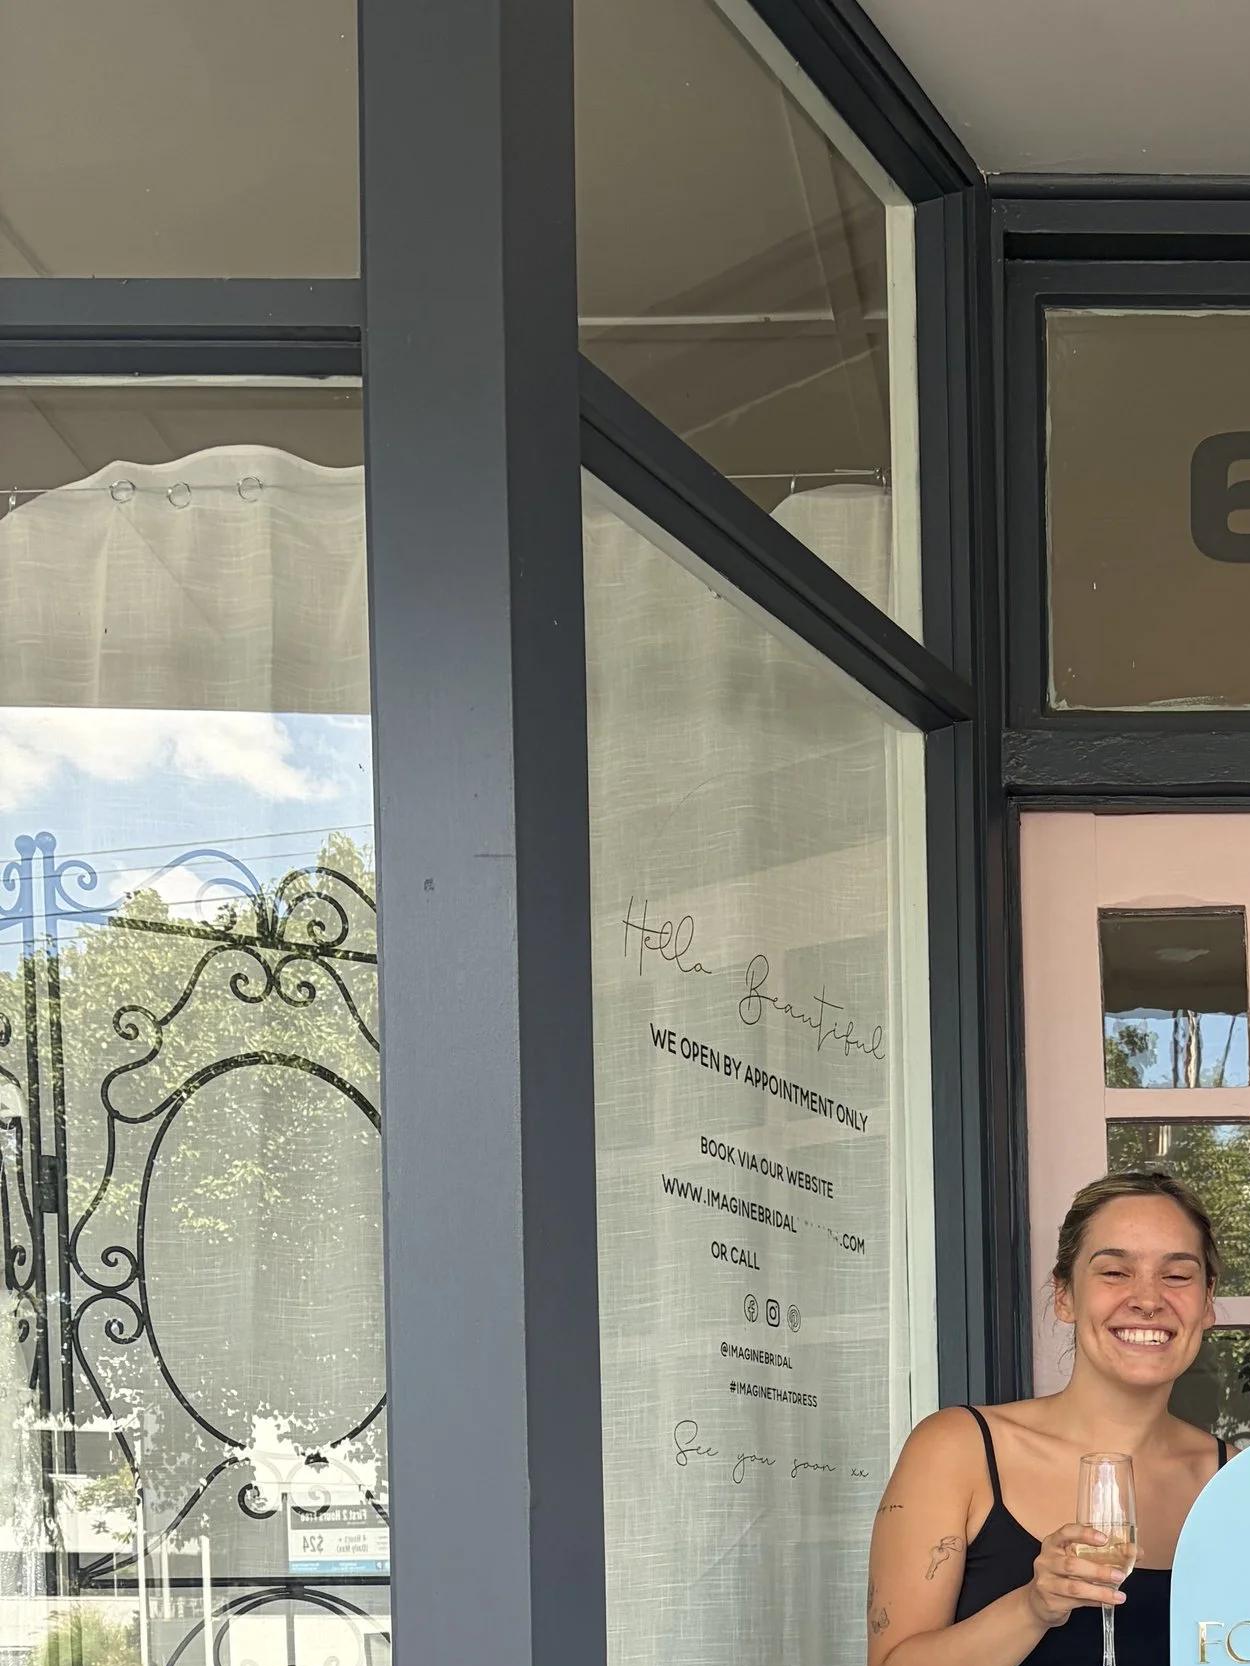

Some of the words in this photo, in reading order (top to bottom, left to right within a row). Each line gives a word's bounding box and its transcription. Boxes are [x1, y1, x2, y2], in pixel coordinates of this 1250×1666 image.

[739, 955, 886, 1060] Beautiful
[649, 1022, 677, 1055] WE
[680, 1037, 720, 1073] OPEN
[723, 1054, 742, 1080] BY
[744, 1064, 835, 1119] APPOINTMENT
[836, 1103, 868, 1133] ONLY
[700, 1136, 736, 1165] BOOK
[737, 1148, 759, 1173] VIA
[760, 1158, 785, 1182] OUR
[786, 1166, 834, 1199] WEBSITE
[711, 1240, 728, 1262] OR
[730, 1247, 760, 1270] CALL
[720, 1341, 793, 1369] @IMAGINEBRIDAL
[729, 1381, 818, 1408] #IMAGINETHATDRESS
[674, 1419, 720, 1466] See
[732, 1453, 776, 1484] you
[791, 1457, 836, 1478] soon
